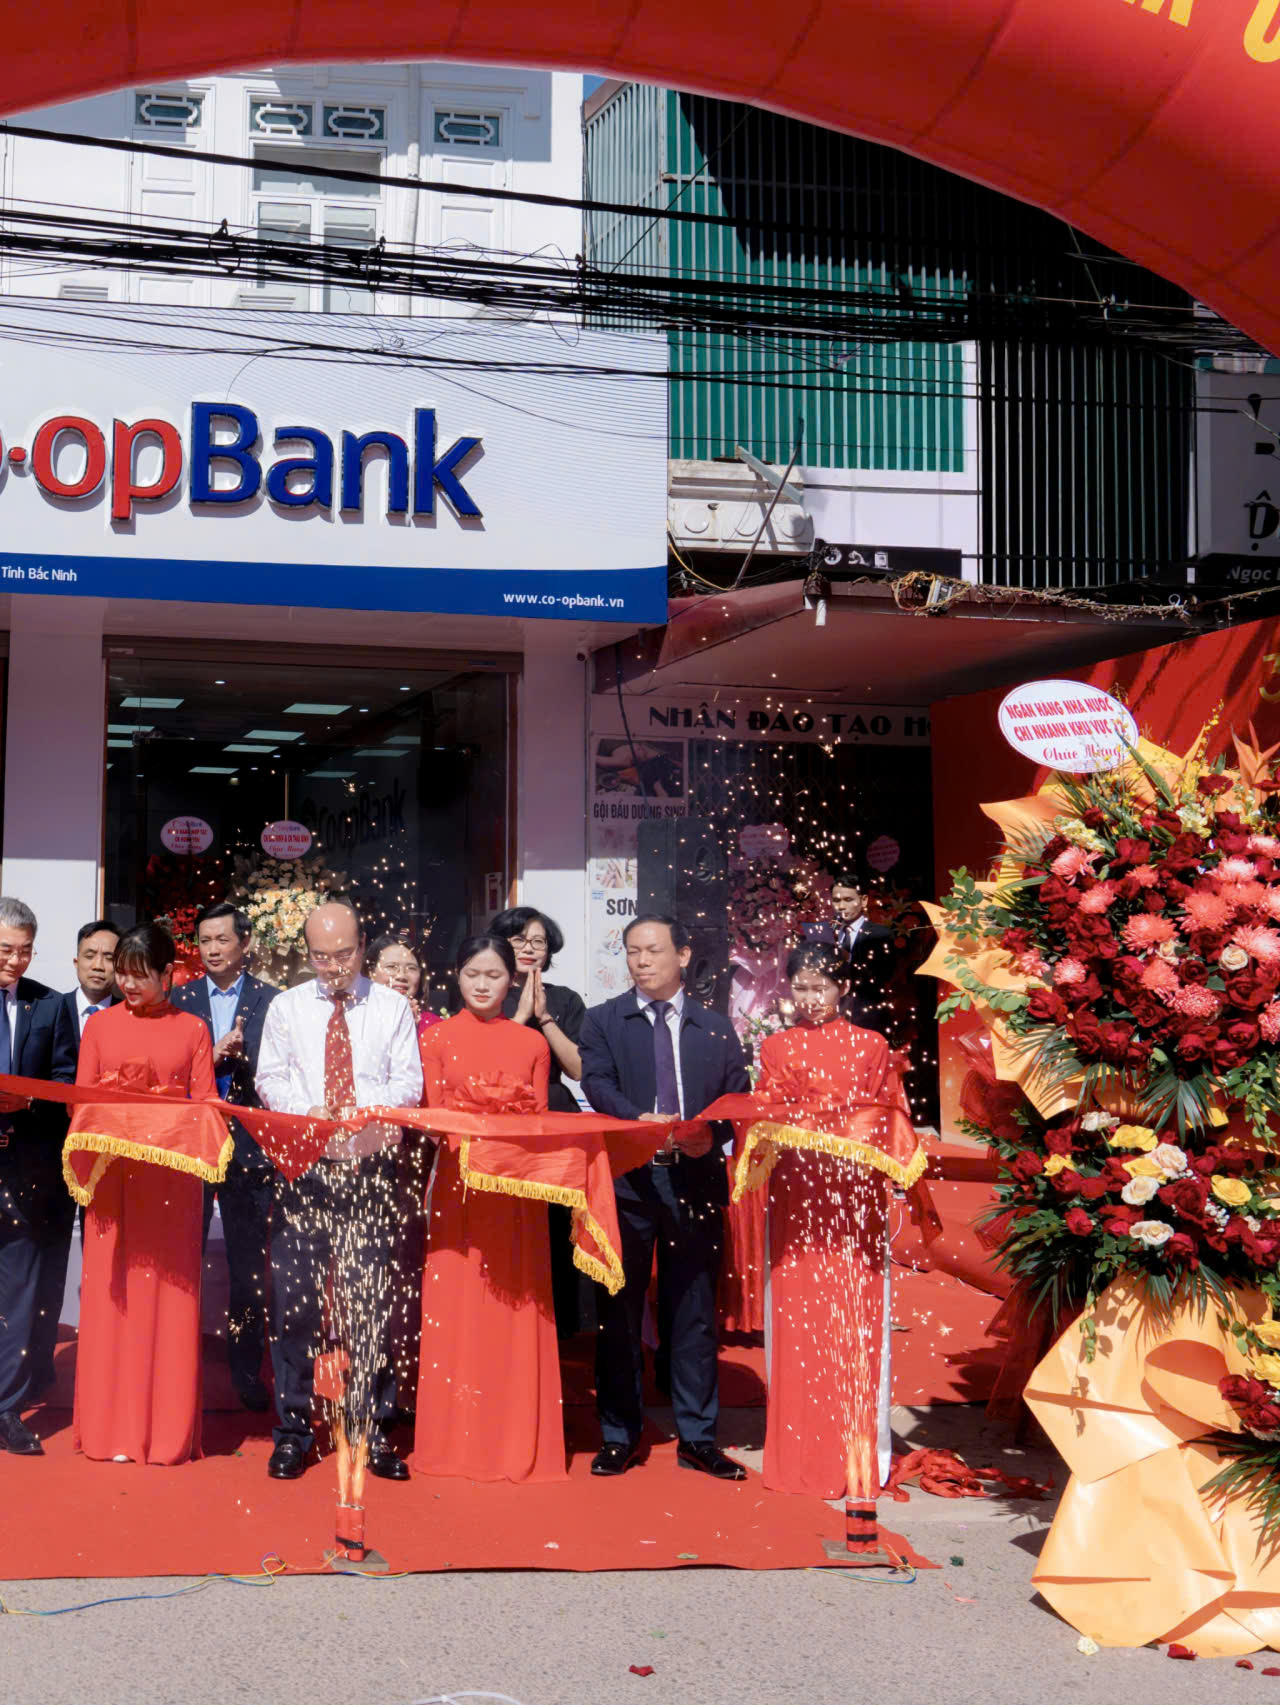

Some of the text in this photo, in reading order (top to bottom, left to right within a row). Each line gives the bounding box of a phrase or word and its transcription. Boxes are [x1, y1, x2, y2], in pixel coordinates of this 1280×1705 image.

[28, 566, 49, 580] Bắc
[51, 569, 77, 582] Ninh
[503, 593, 624, 609] www.co-opbank.vn
[826, 714, 891, 741] TẠO
[1068, 721, 1093, 736] KHU
